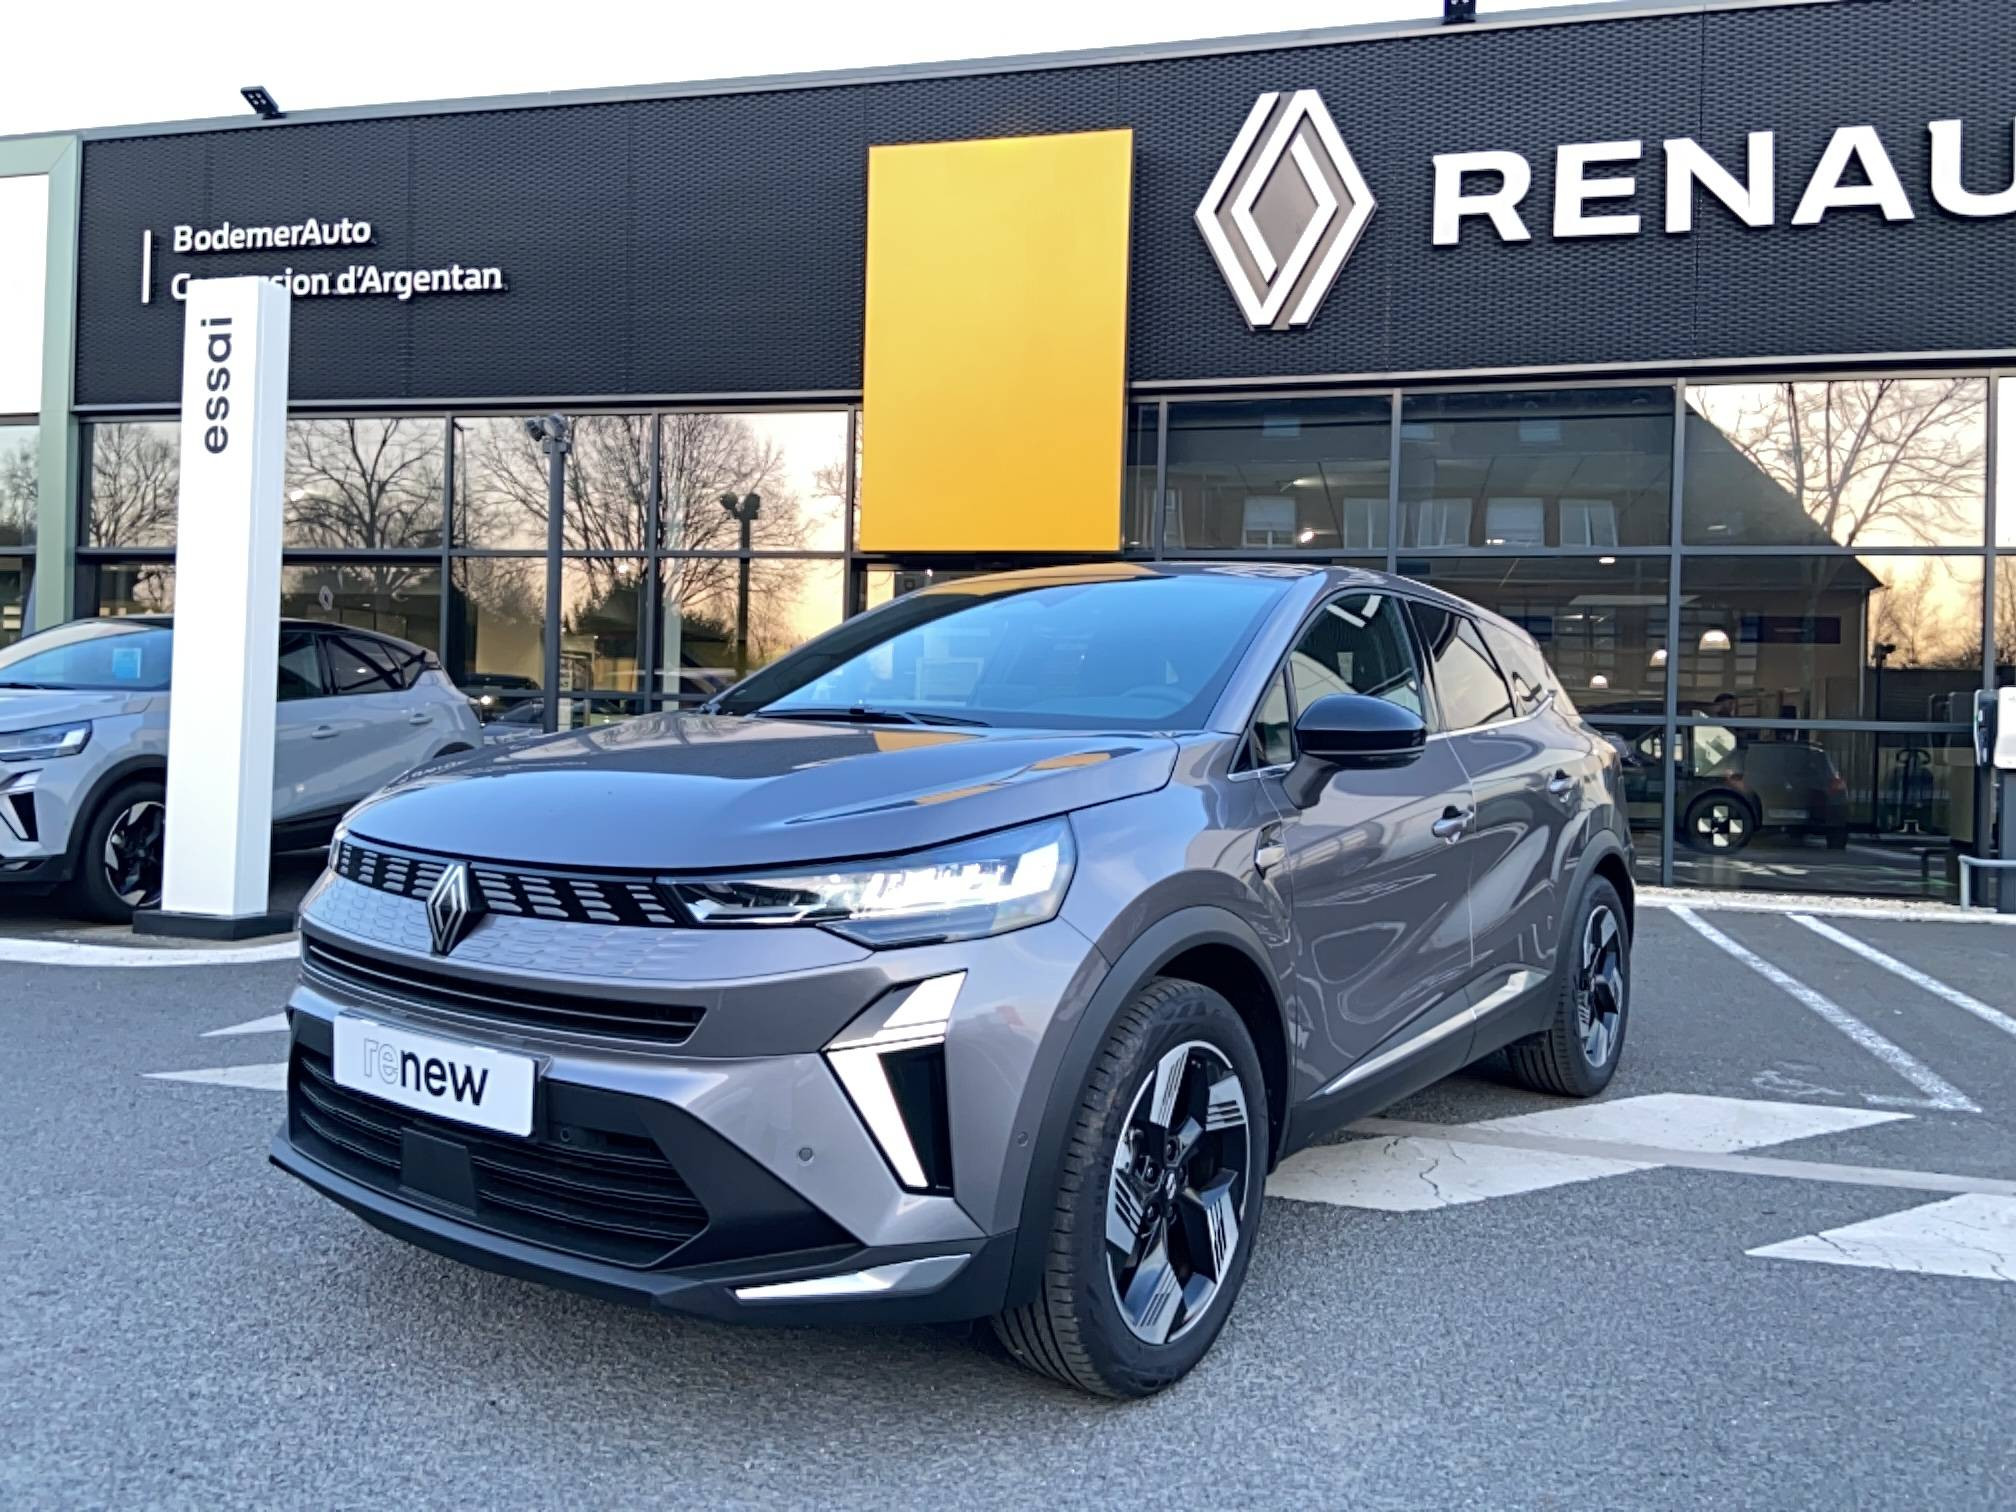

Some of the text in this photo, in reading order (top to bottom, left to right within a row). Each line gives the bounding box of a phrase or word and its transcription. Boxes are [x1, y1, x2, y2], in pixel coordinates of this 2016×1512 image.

[1432, 116, 2016, 245] RENAU
[173, 218, 371, 252] BodemerAuto
[336, 264, 502, 300] d'Argentan
[200, 316, 233, 454] essai
[363, 1037, 489, 1107] renew
